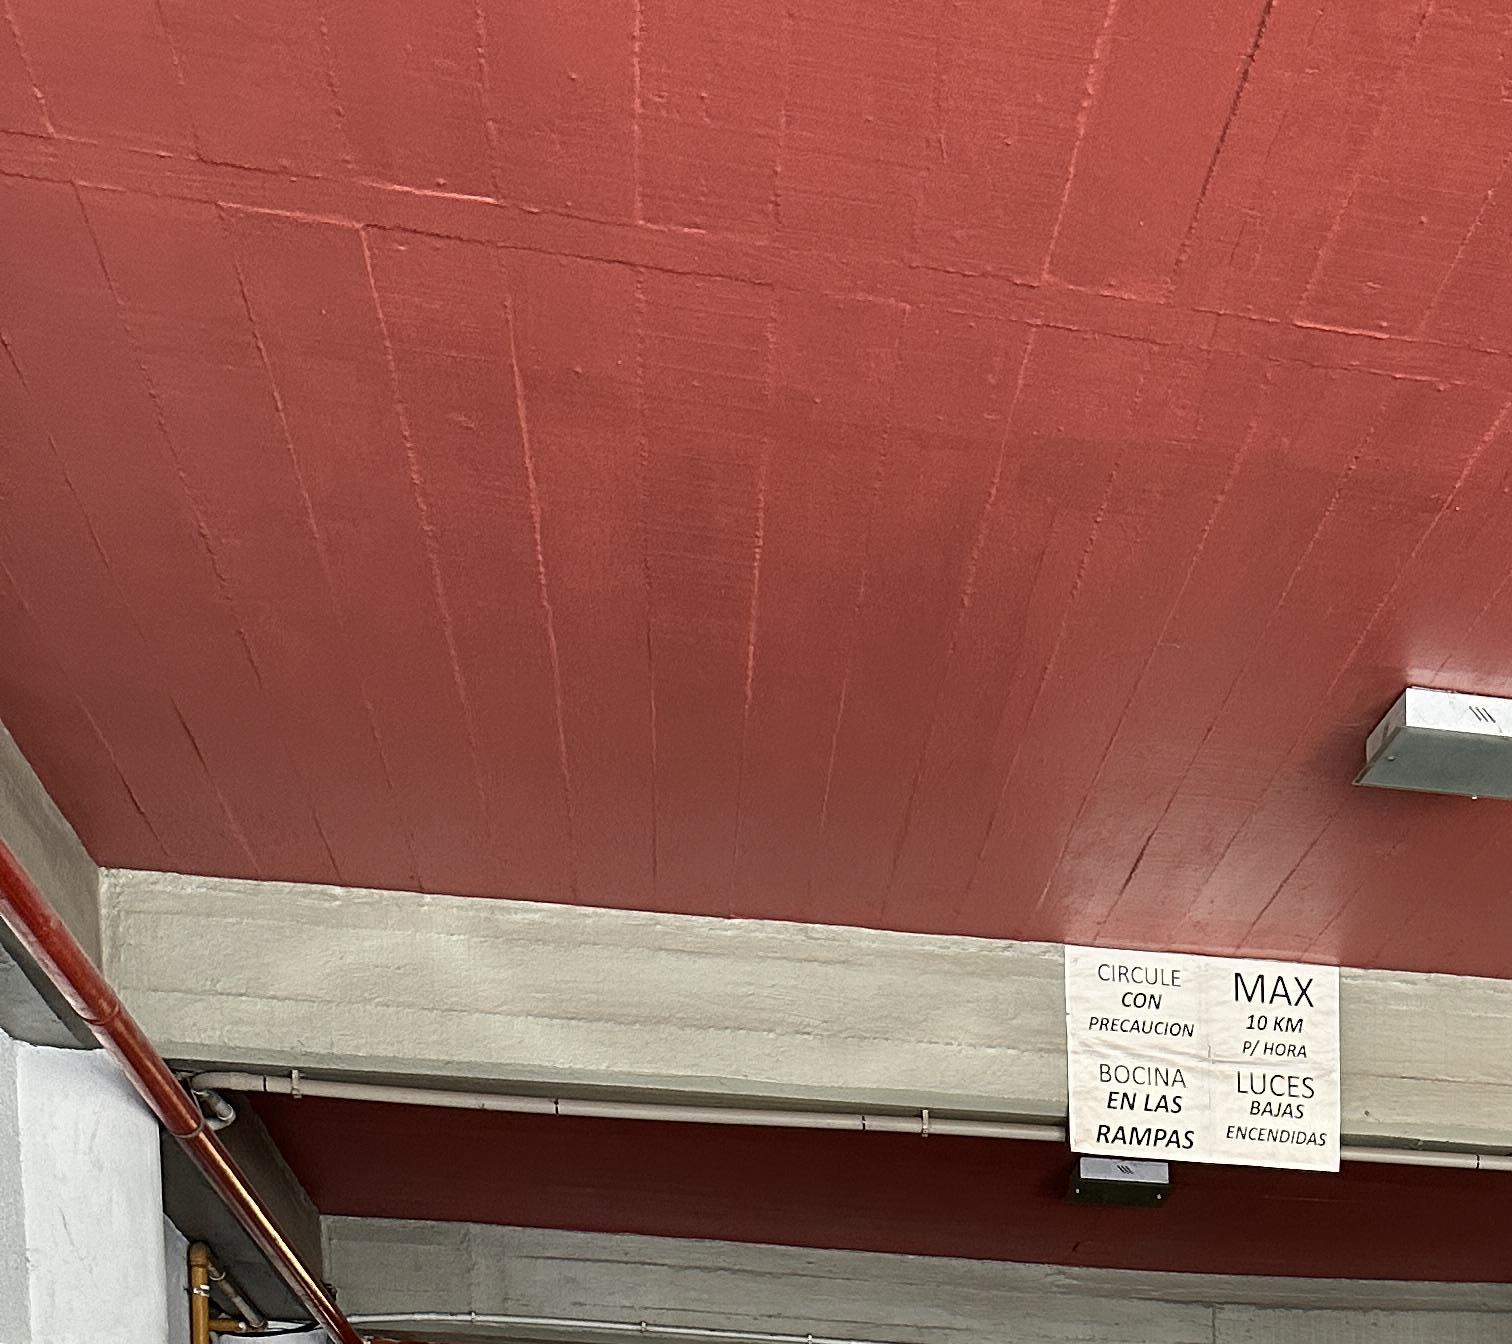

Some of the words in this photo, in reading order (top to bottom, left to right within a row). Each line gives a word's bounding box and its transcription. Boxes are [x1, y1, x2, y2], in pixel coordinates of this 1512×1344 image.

[1097, 963, 1181, 988] CIRCULE
[1121, 991, 1162, 1010] CON
[1234, 972, 1314, 1008] MAX
[1088, 1016, 1195, 1038] PRECAUCION
[1246, 1014, 1268, 1031] 10
[1273, 1016, 1304, 1034] KM
[1242, 1040, 1260, 1057] P/
[1263, 1042, 1307, 1059] HORA
[1099, 1063, 1187, 1089] BOCINA
[1237, 1070, 1315, 1099] LUCES
[1106, 1091, 1137, 1111] EN
[1143, 1094, 1183, 1114] LAS
[1250, 1100, 1305, 1120] BAJAS
[1096, 1124, 1195, 1150] RAMPAS
[1226, 1125, 1328, 1147] ENCENDIDAS
